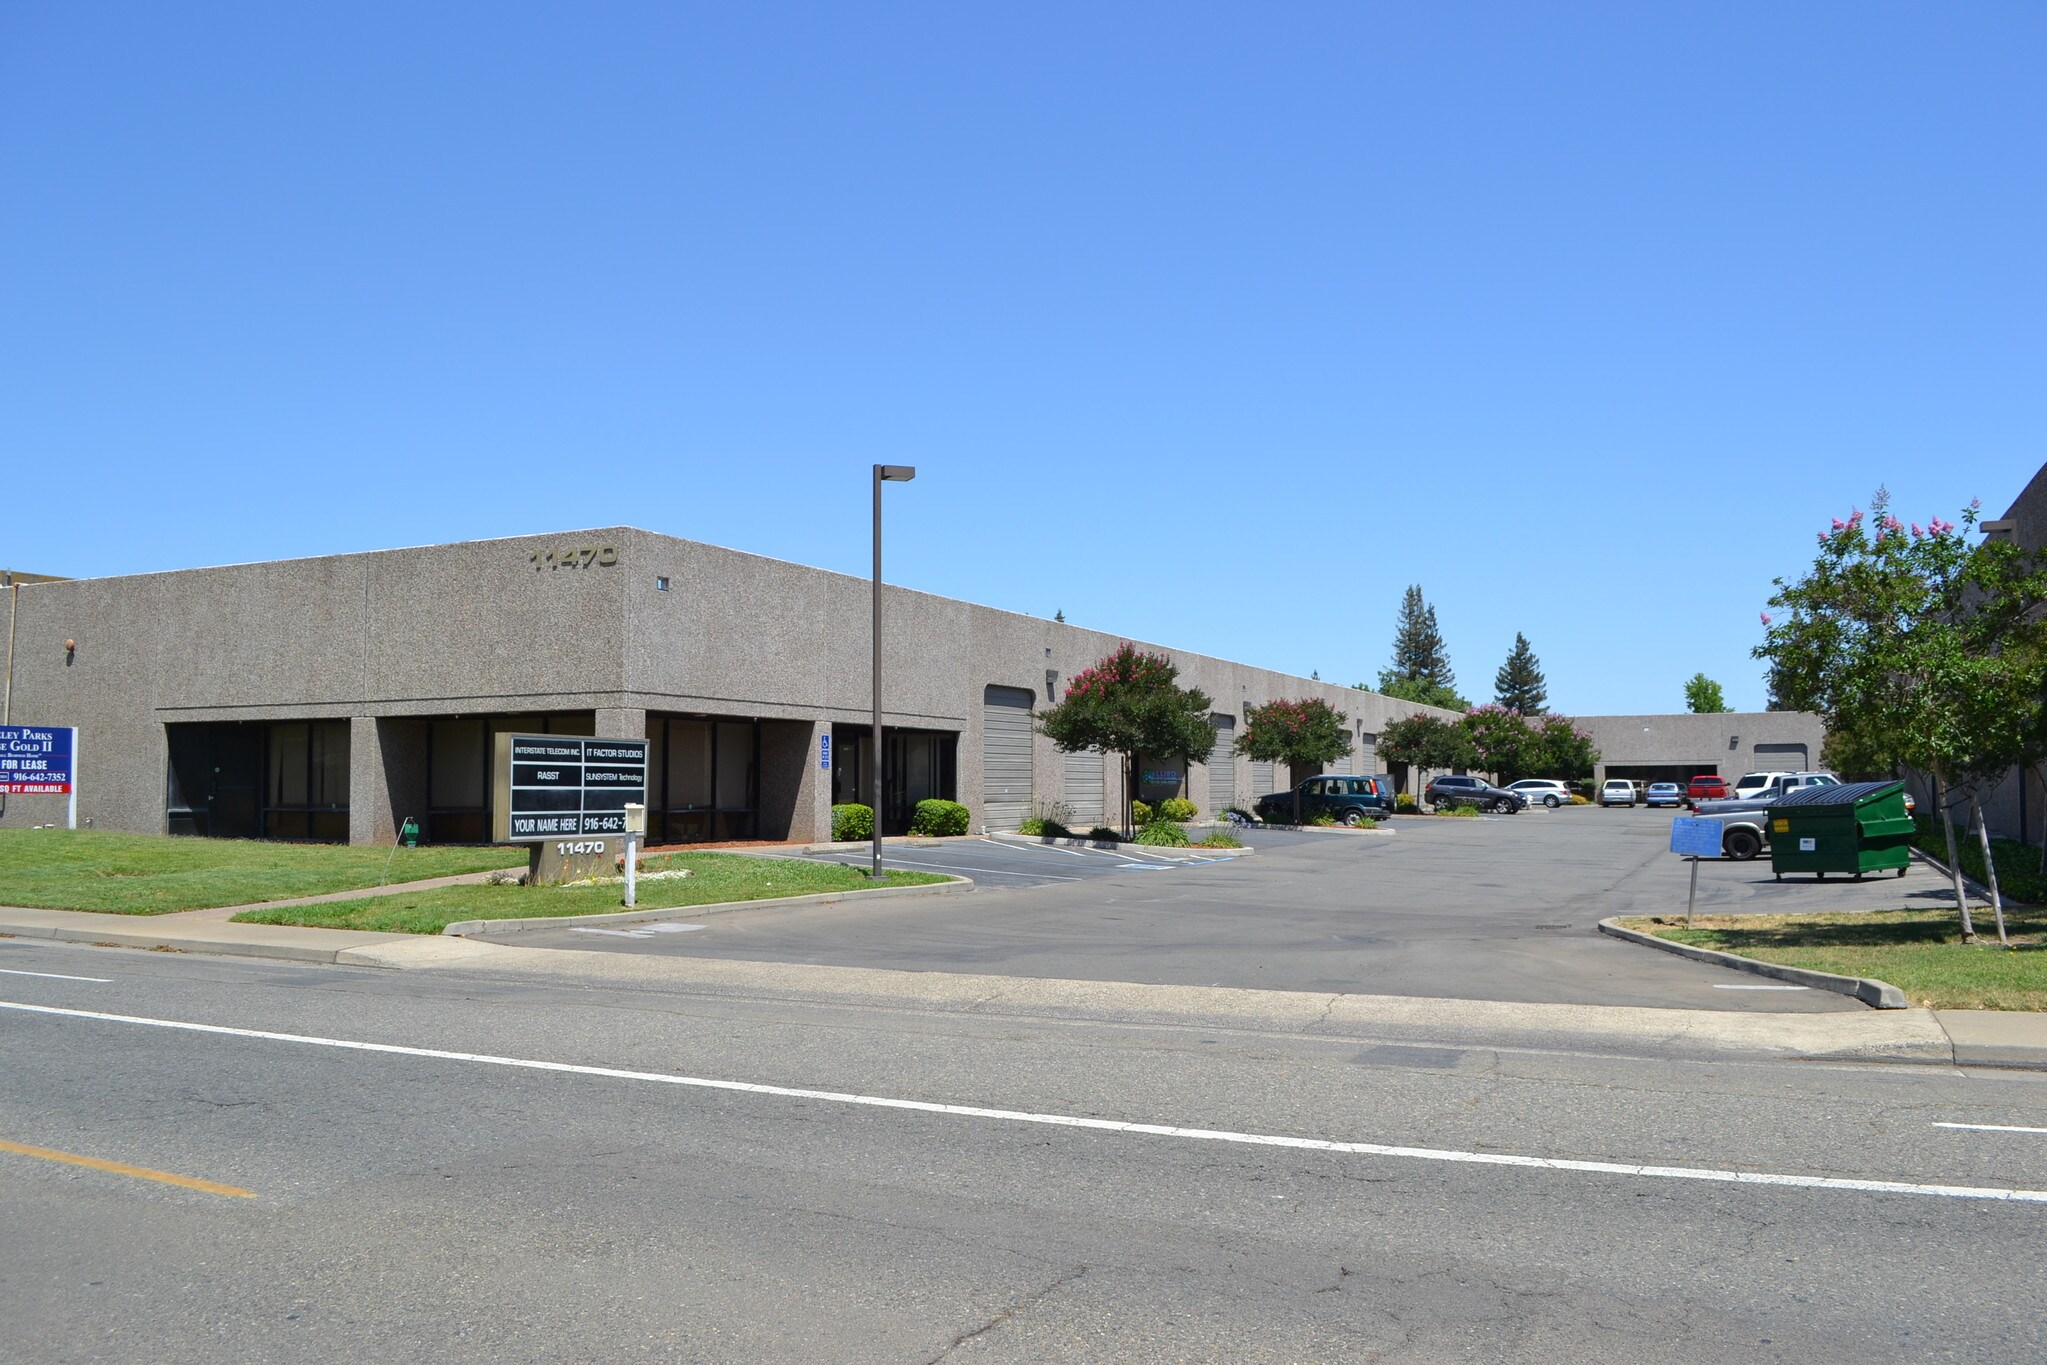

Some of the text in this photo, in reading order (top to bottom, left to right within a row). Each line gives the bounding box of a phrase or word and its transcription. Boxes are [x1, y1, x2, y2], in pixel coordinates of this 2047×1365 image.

[530, 543, 618, 570] 11470
[0, 729, 53, 740] LEY PARKS
[0, 740, 52, 752] E GOLD II
[514, 746, 546, 755] INTERSTATE
[546, 747, 570, 756] TELECOM
[586, 748, 643, 759] IT FACTOR STUDIOS
[1, 759, 48, 770] FOR LEASE
[13, 772, 66, 781] 916-642-7352
[537, 771, 560, 780] RASST
[585, 772, 643, 783] SUNSYSTEM Technology
[24, 785, 63, 793] AVAILABLE
[514, 818, 577, 832] YOUR NAME HERE
[584, 816, 626, 830] 916-642-7
[557, 841, 605, 855] 11470
